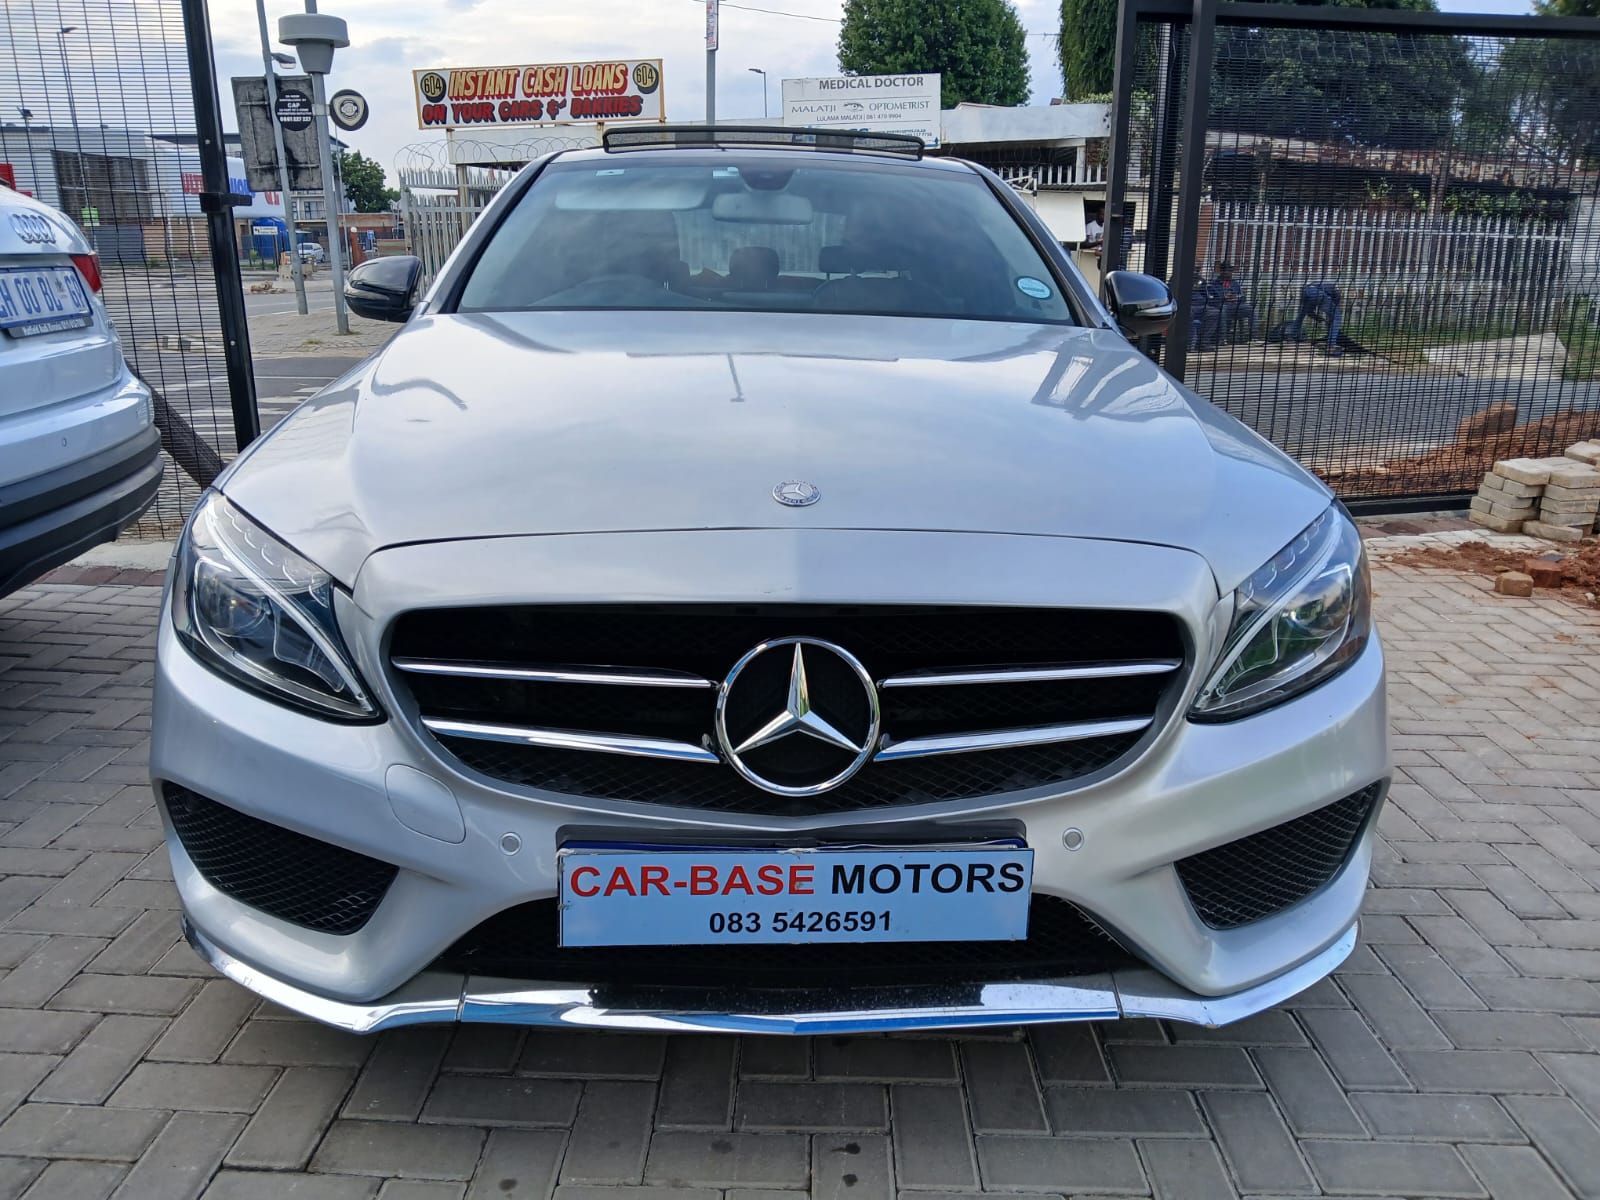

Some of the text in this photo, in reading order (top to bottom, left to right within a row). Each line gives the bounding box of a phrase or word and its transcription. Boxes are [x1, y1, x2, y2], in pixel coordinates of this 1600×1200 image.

[448, 63, 628, 101] INSTANT CASH LOANS
[818, 76, 924, 90] MEDICAL DOCTOR
[422, 104, 448, 125] ON
[451, 102, 497, 124] YOUR
[498, 98, 543, 122] CARS
[570, 95, 644, 119] BAKKIES
[868, 100, 930, 111] OPTOMETRIST
[570, 862, 1024, 897] CAR-BASE MOTORS
[709, 910, 891, 933] 083 5426591
